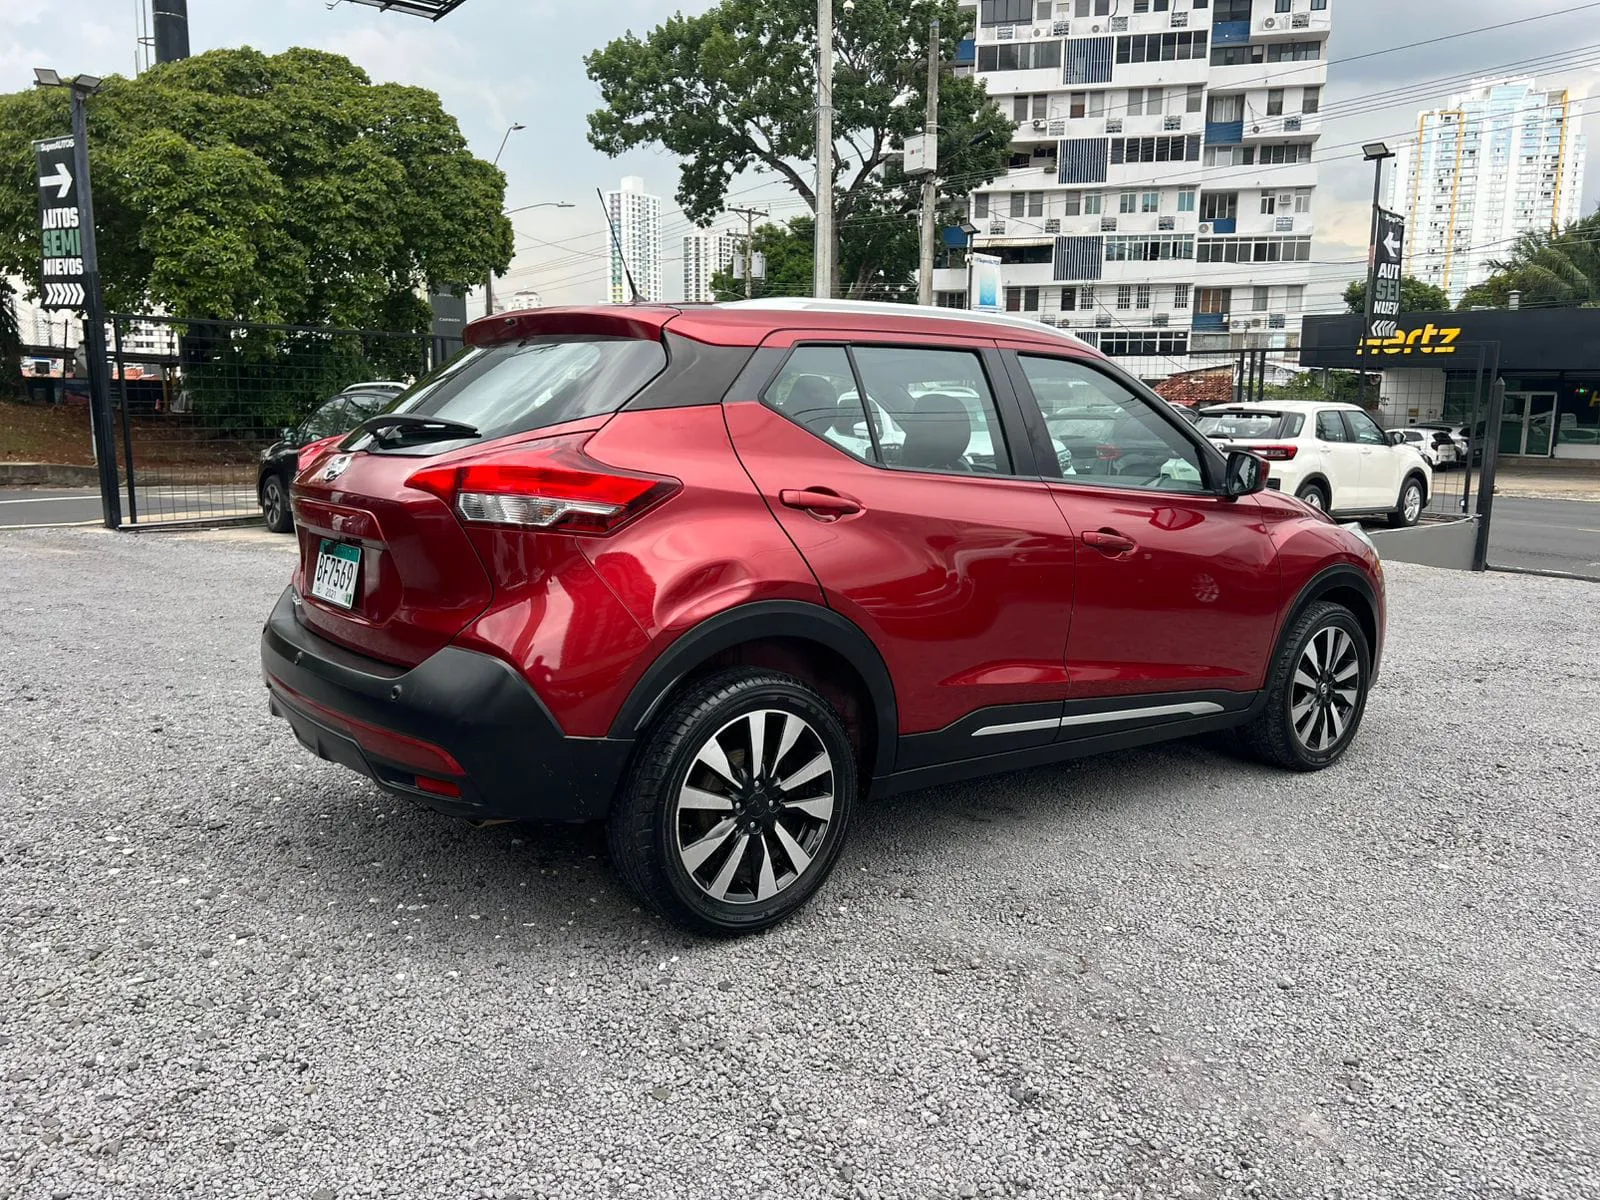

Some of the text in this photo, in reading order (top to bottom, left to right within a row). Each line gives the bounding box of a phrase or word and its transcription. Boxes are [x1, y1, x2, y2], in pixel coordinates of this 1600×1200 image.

[42, 207, 80, 230] AUTOS
[43, 229, 82, 257] SEMI
[316, 553, 354, 592] BF7569
